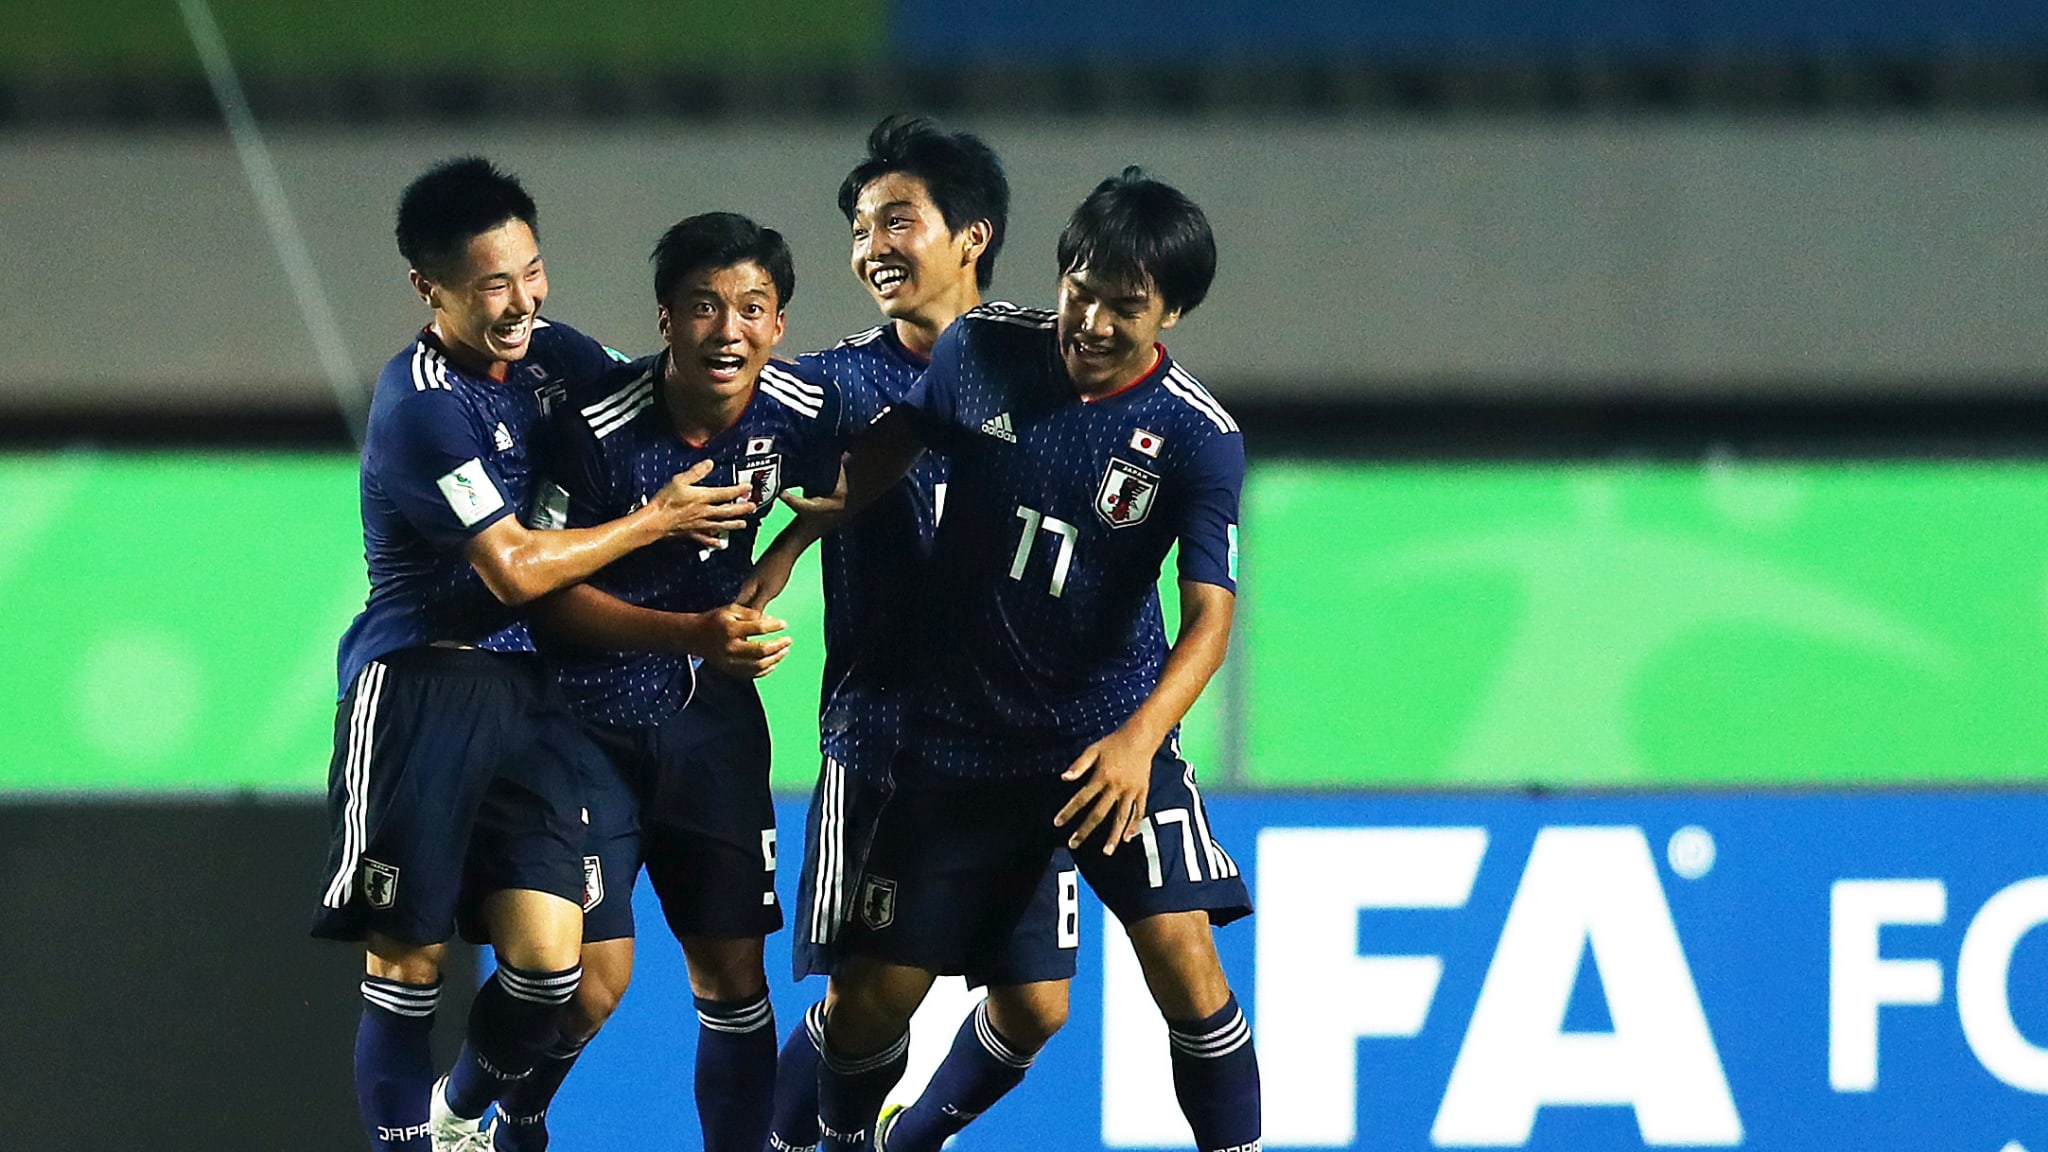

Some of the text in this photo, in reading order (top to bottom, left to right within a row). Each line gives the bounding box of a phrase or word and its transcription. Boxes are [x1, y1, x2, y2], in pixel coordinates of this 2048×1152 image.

[981, 423, 1017, 444] adidas
[746, 459, 771, 469] JAPAN
[1122, 465, 1149, 480] JAPAN
[1009, 505, 1079, 598] 17
[377, 1121, 432, 1142] JAPA
